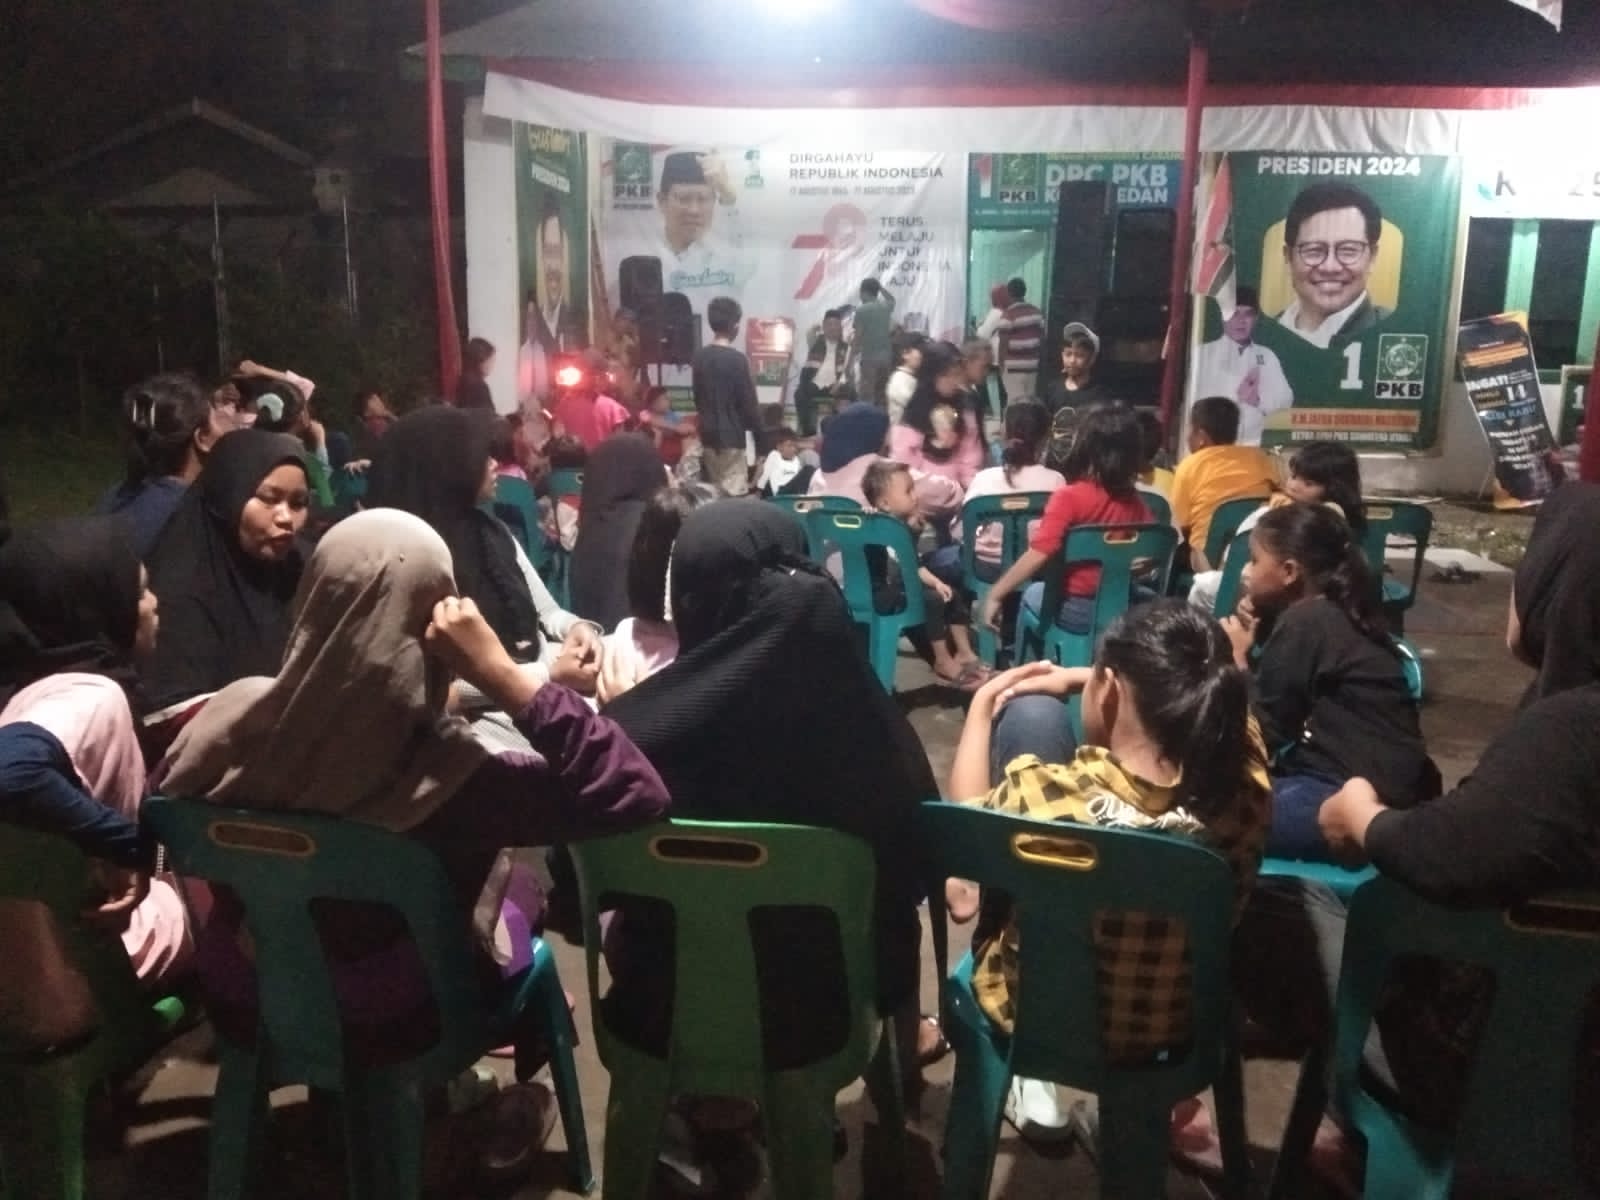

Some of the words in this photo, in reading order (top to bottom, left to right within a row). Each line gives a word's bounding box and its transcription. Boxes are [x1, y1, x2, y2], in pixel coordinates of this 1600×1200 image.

[789, 153, 874, 164] DIRGAHAYU
[789, 168, 860, 179] REPUBLIK
[864, 167, 944, 179] INDONESIA
[1257, 156, 1363, 176] PRESIDEN
[1366, 157, 1422, 177] 2024
[1112, 164, 1169, 187] PKB
[613, 185, 651, 198] PKB
[1000, 190, 1037, 202] PKB
[1116, 188, 1169, 203] EDAN
[880, 216, 924, 227] TERUS
[1339, 341, 1364, 390] 1
[1375, 382, 1423, 398] PKB
